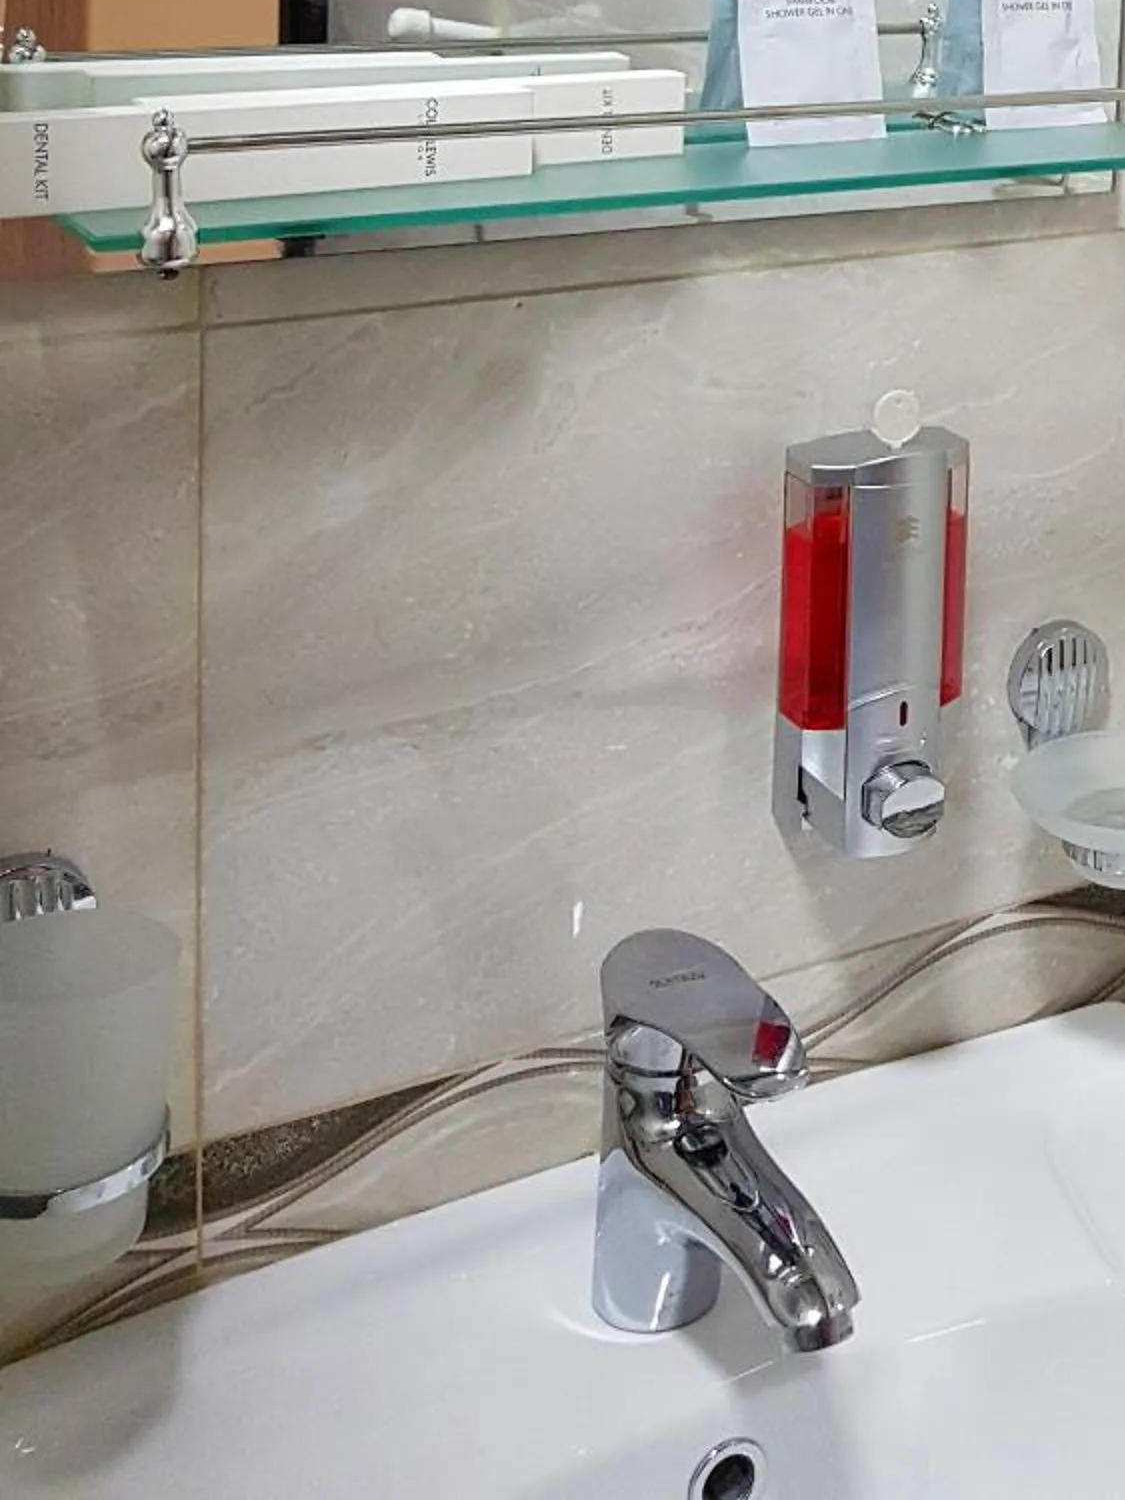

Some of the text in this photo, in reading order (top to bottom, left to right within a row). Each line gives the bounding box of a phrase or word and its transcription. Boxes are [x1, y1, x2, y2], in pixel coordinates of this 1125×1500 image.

[764, 7, 805, 19] SHOWER
[33, 123, 49, 199] DENTAL KIT
